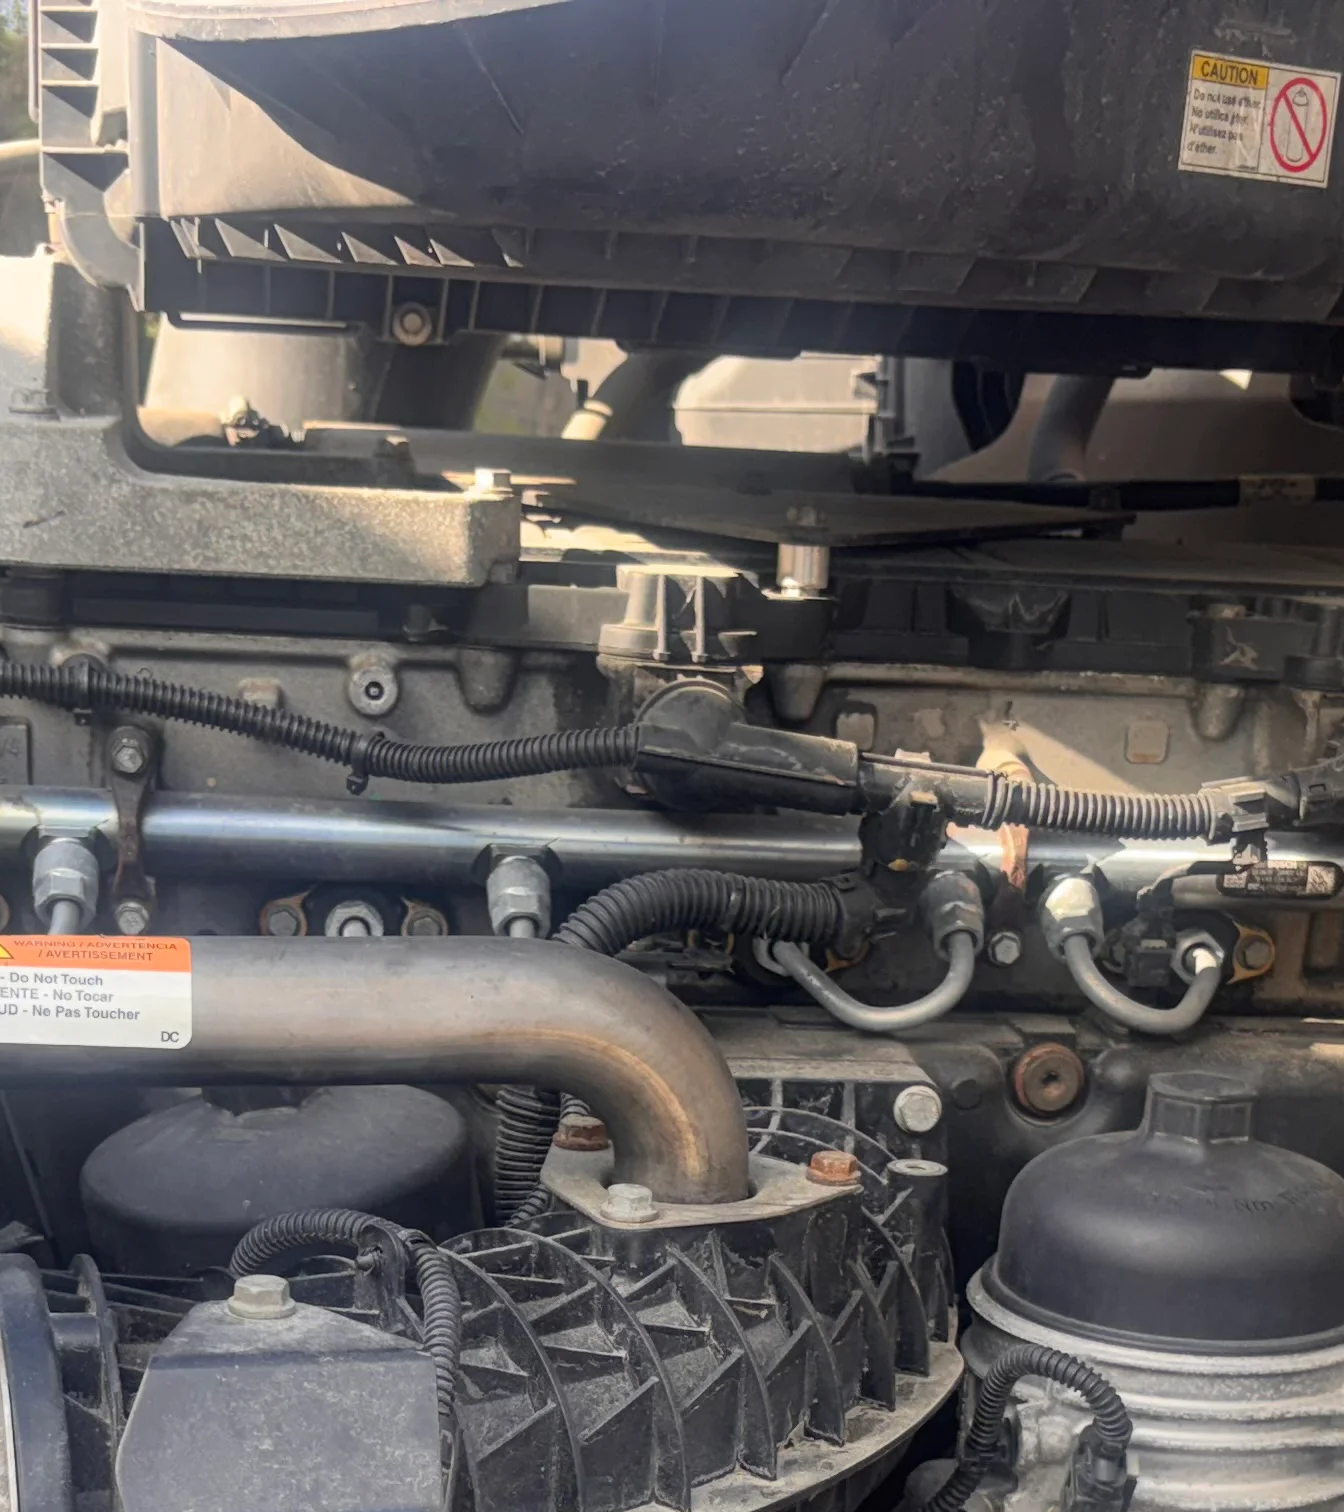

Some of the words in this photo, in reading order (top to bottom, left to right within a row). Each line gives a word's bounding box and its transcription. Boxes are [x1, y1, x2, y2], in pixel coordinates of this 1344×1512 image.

[1201, 61, 1259, 86] CAUTION
[13, 940, 76, 949] WARNING
[87, 941, 177, 951] ADVERTENCIA
[45, 949, 154, 961] AVERTISSEMENT
[9, 972, 30, 984] Do
[33, 973, 58, 985] Not
[61, 974, 103, 986] Touch
[53, 989, 73, 1002] No
[75, 990, 115, 1003] Tocar
[32, 1005, 51, 1017] Ne
[55, 1006, 81, 1018] Pas
[85, 1007, 141, 1020] Toucher
[160, 1031, 179, 1043] DC
